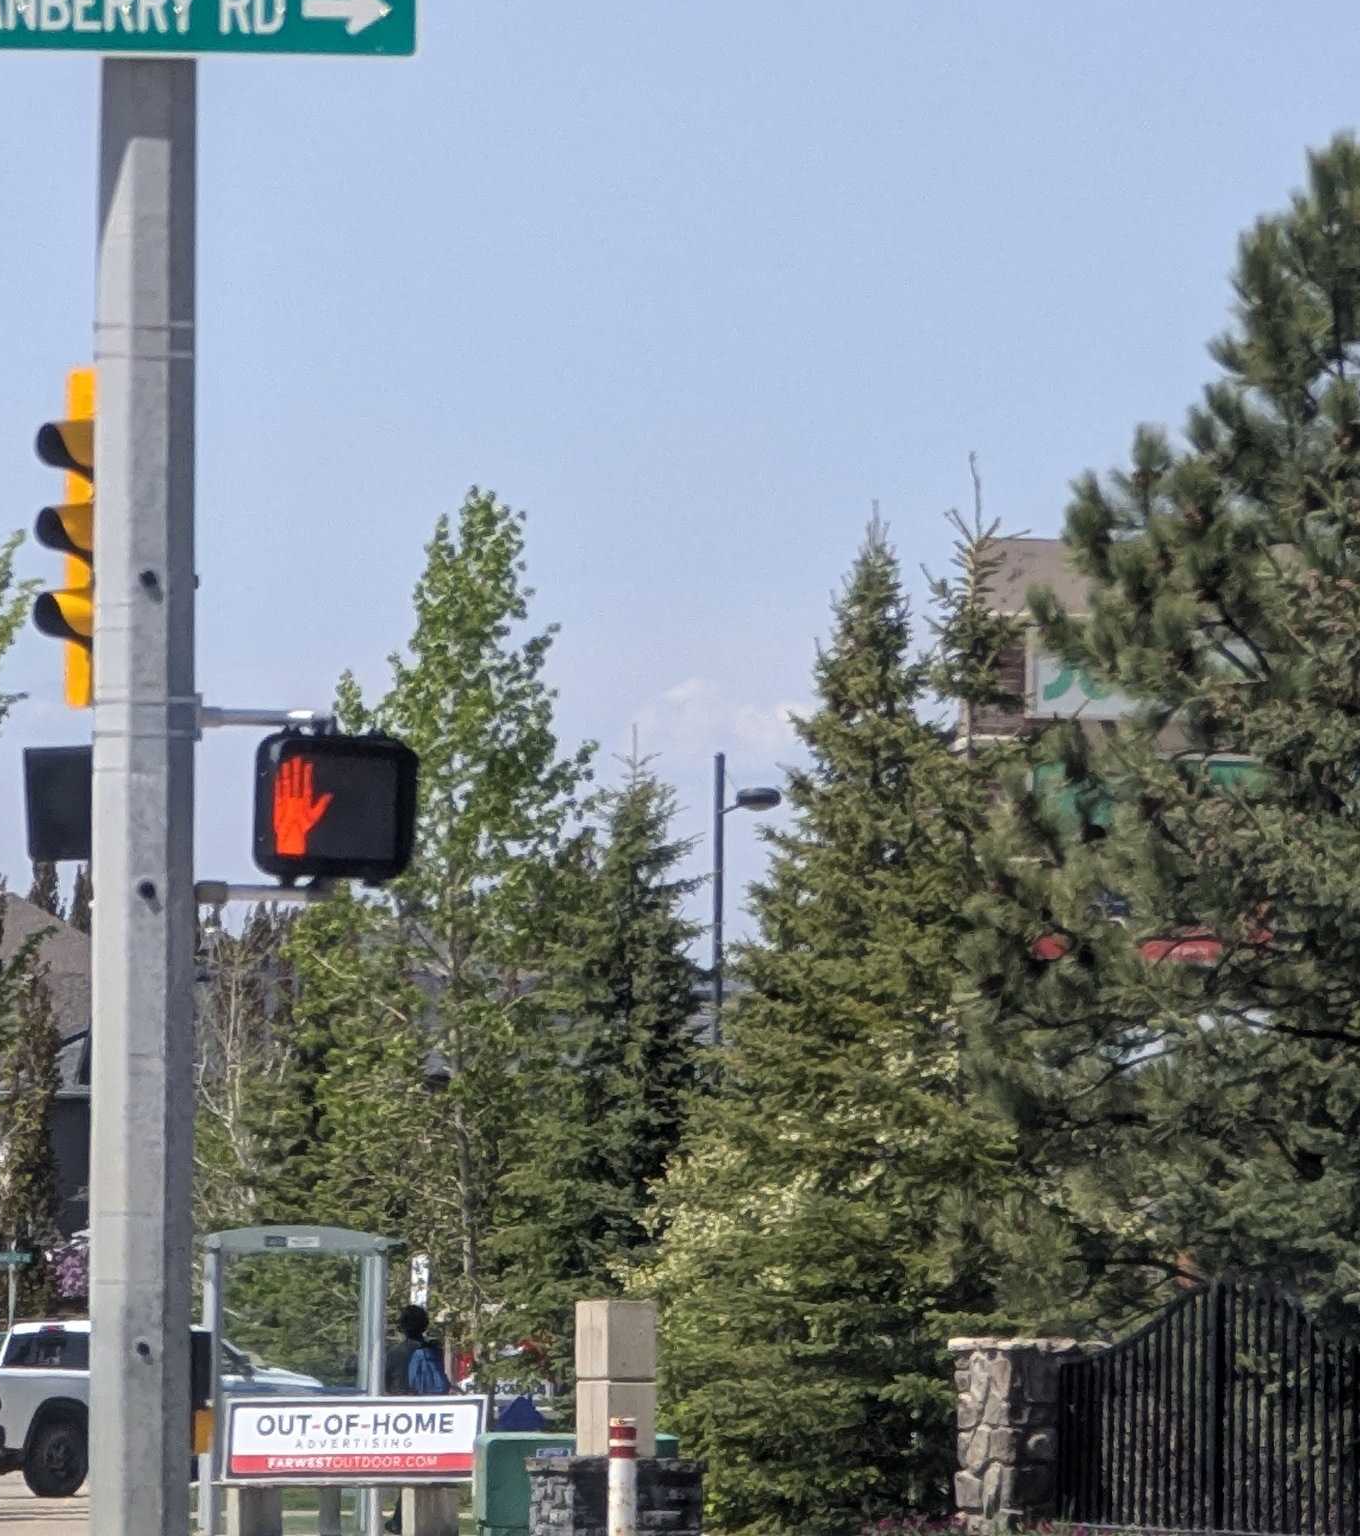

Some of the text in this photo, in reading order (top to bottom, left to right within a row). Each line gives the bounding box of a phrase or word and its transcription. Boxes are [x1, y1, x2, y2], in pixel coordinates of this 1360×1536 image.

[257, 1413, 455, 1436] OUT-OF-HOME
[295, 1438, 413, 1450] ADVERTISING
[267, 1456, 438, 1468] FARWESTOUTDOOR.COM
